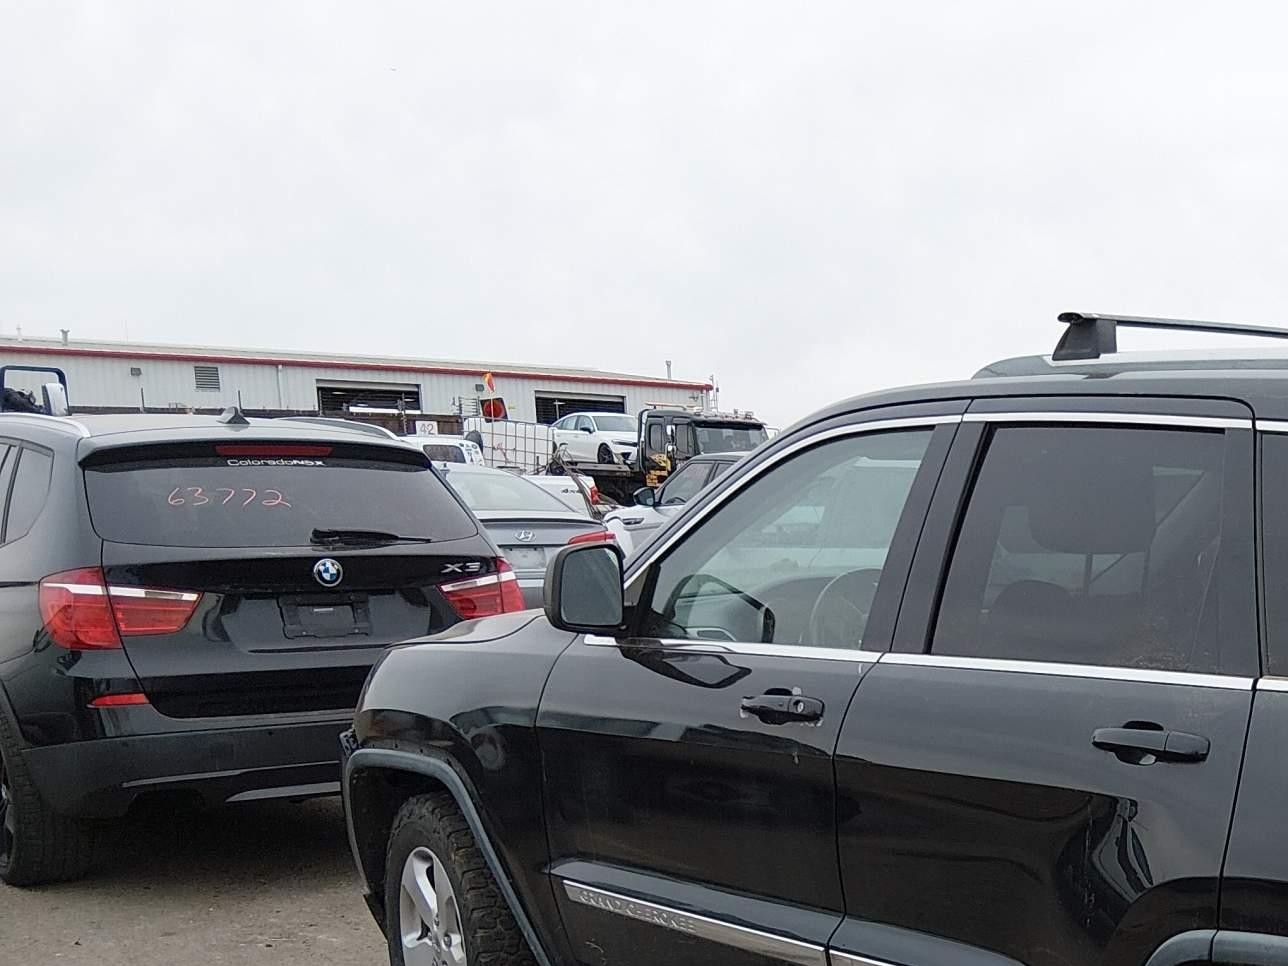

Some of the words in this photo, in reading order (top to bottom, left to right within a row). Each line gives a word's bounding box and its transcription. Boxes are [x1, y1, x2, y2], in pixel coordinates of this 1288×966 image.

[419, 423, 436, 435] 42
[167, 486, 293, 509] 63772
[441, 562, 481, 574] X3
